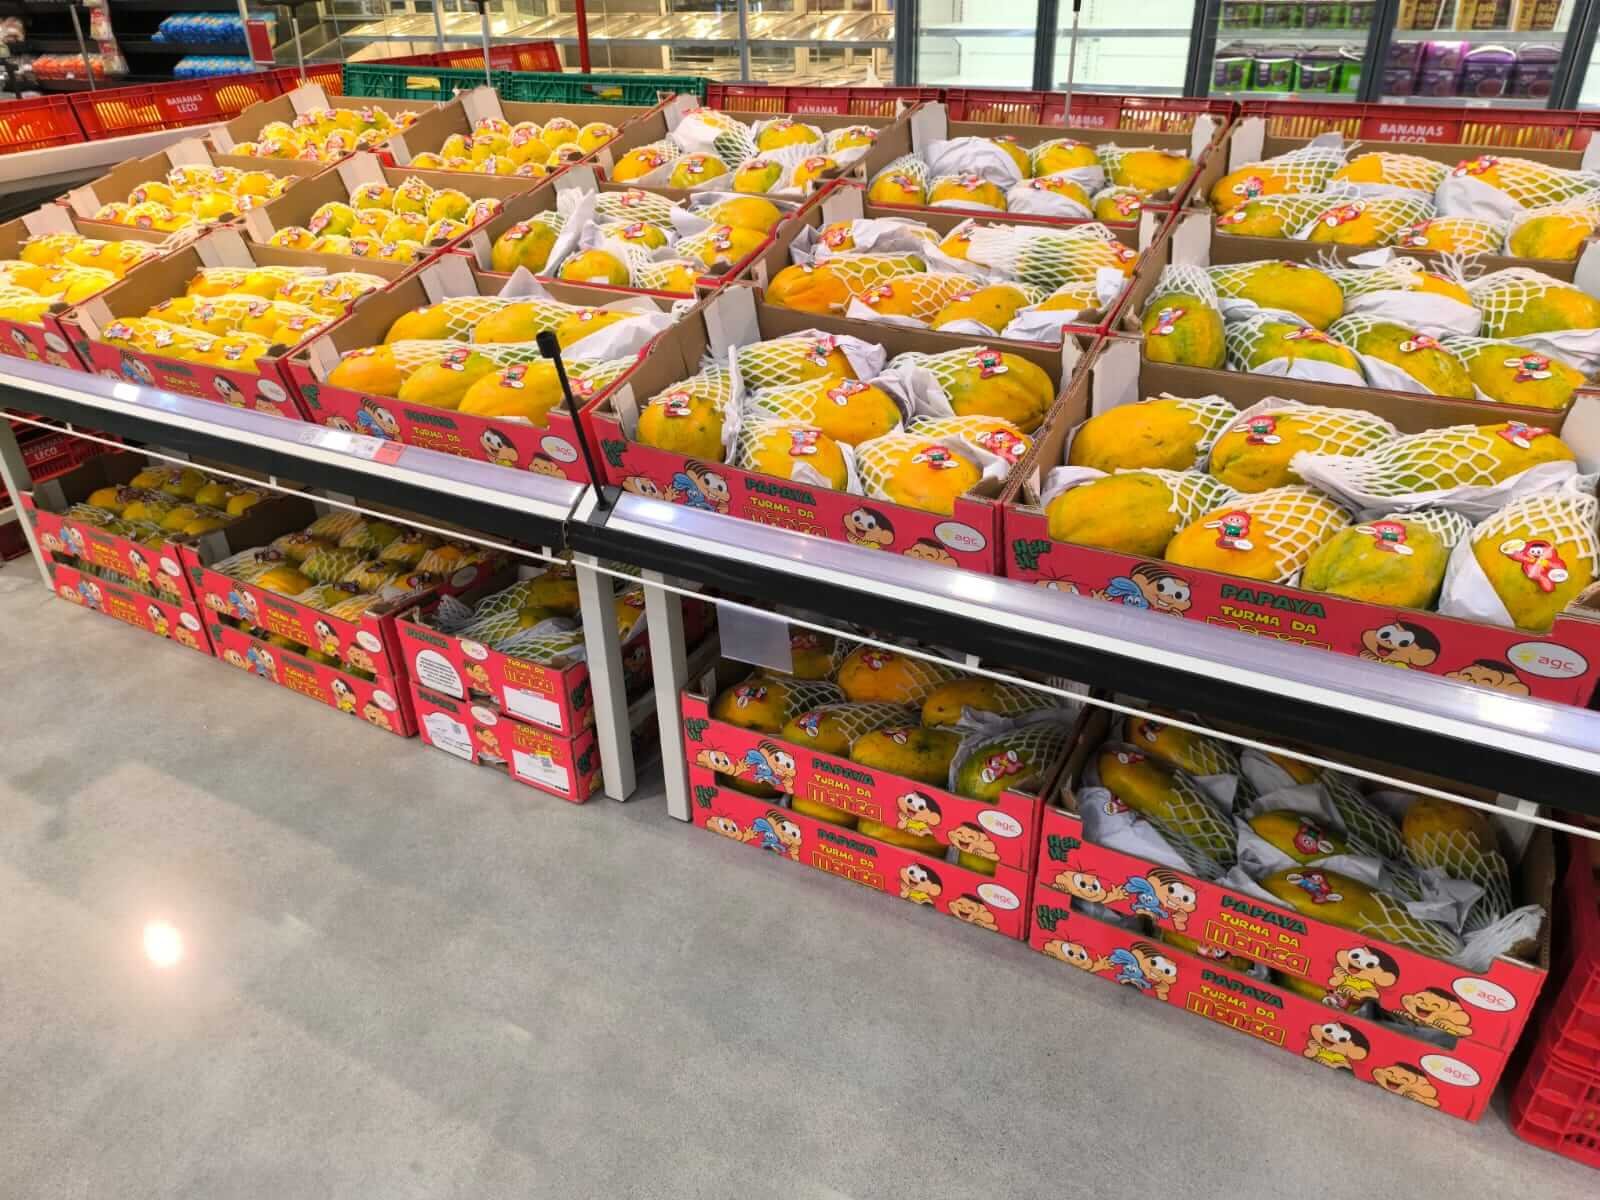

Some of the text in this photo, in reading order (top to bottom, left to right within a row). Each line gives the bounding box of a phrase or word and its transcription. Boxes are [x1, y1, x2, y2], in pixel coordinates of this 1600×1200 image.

[166, 95, 203, 106] BANANAS
[797, 104, 839, 114] BANANAS
[1379, 123, 1445, 137] BANANAS
[750, 496, 791, 514] TURMA
[1221, 584, 1326, 619] PAPAYA
[1220, 605, 1281, 627] TURMA
[1290, 620, 1318, 635] DA
[1537, 655, 1577, 671] agc
[812, 758, 876, 787] PAPAYA
[814, 774, 873, 800] TURMA DA
[818, 844, 876, 870] TURMA DA
[1220, 895, 1308, 936] PAPAYA
[1219, 912, 1301, 948] TURMA DA
[1201, 969, 1284, 1009] PAPAYA
[1477, 989, 1507, 1008] agc
[1199, 985, 1277, 1020] TURMA DA
[1443, 1064, 1474, 1081] agc
